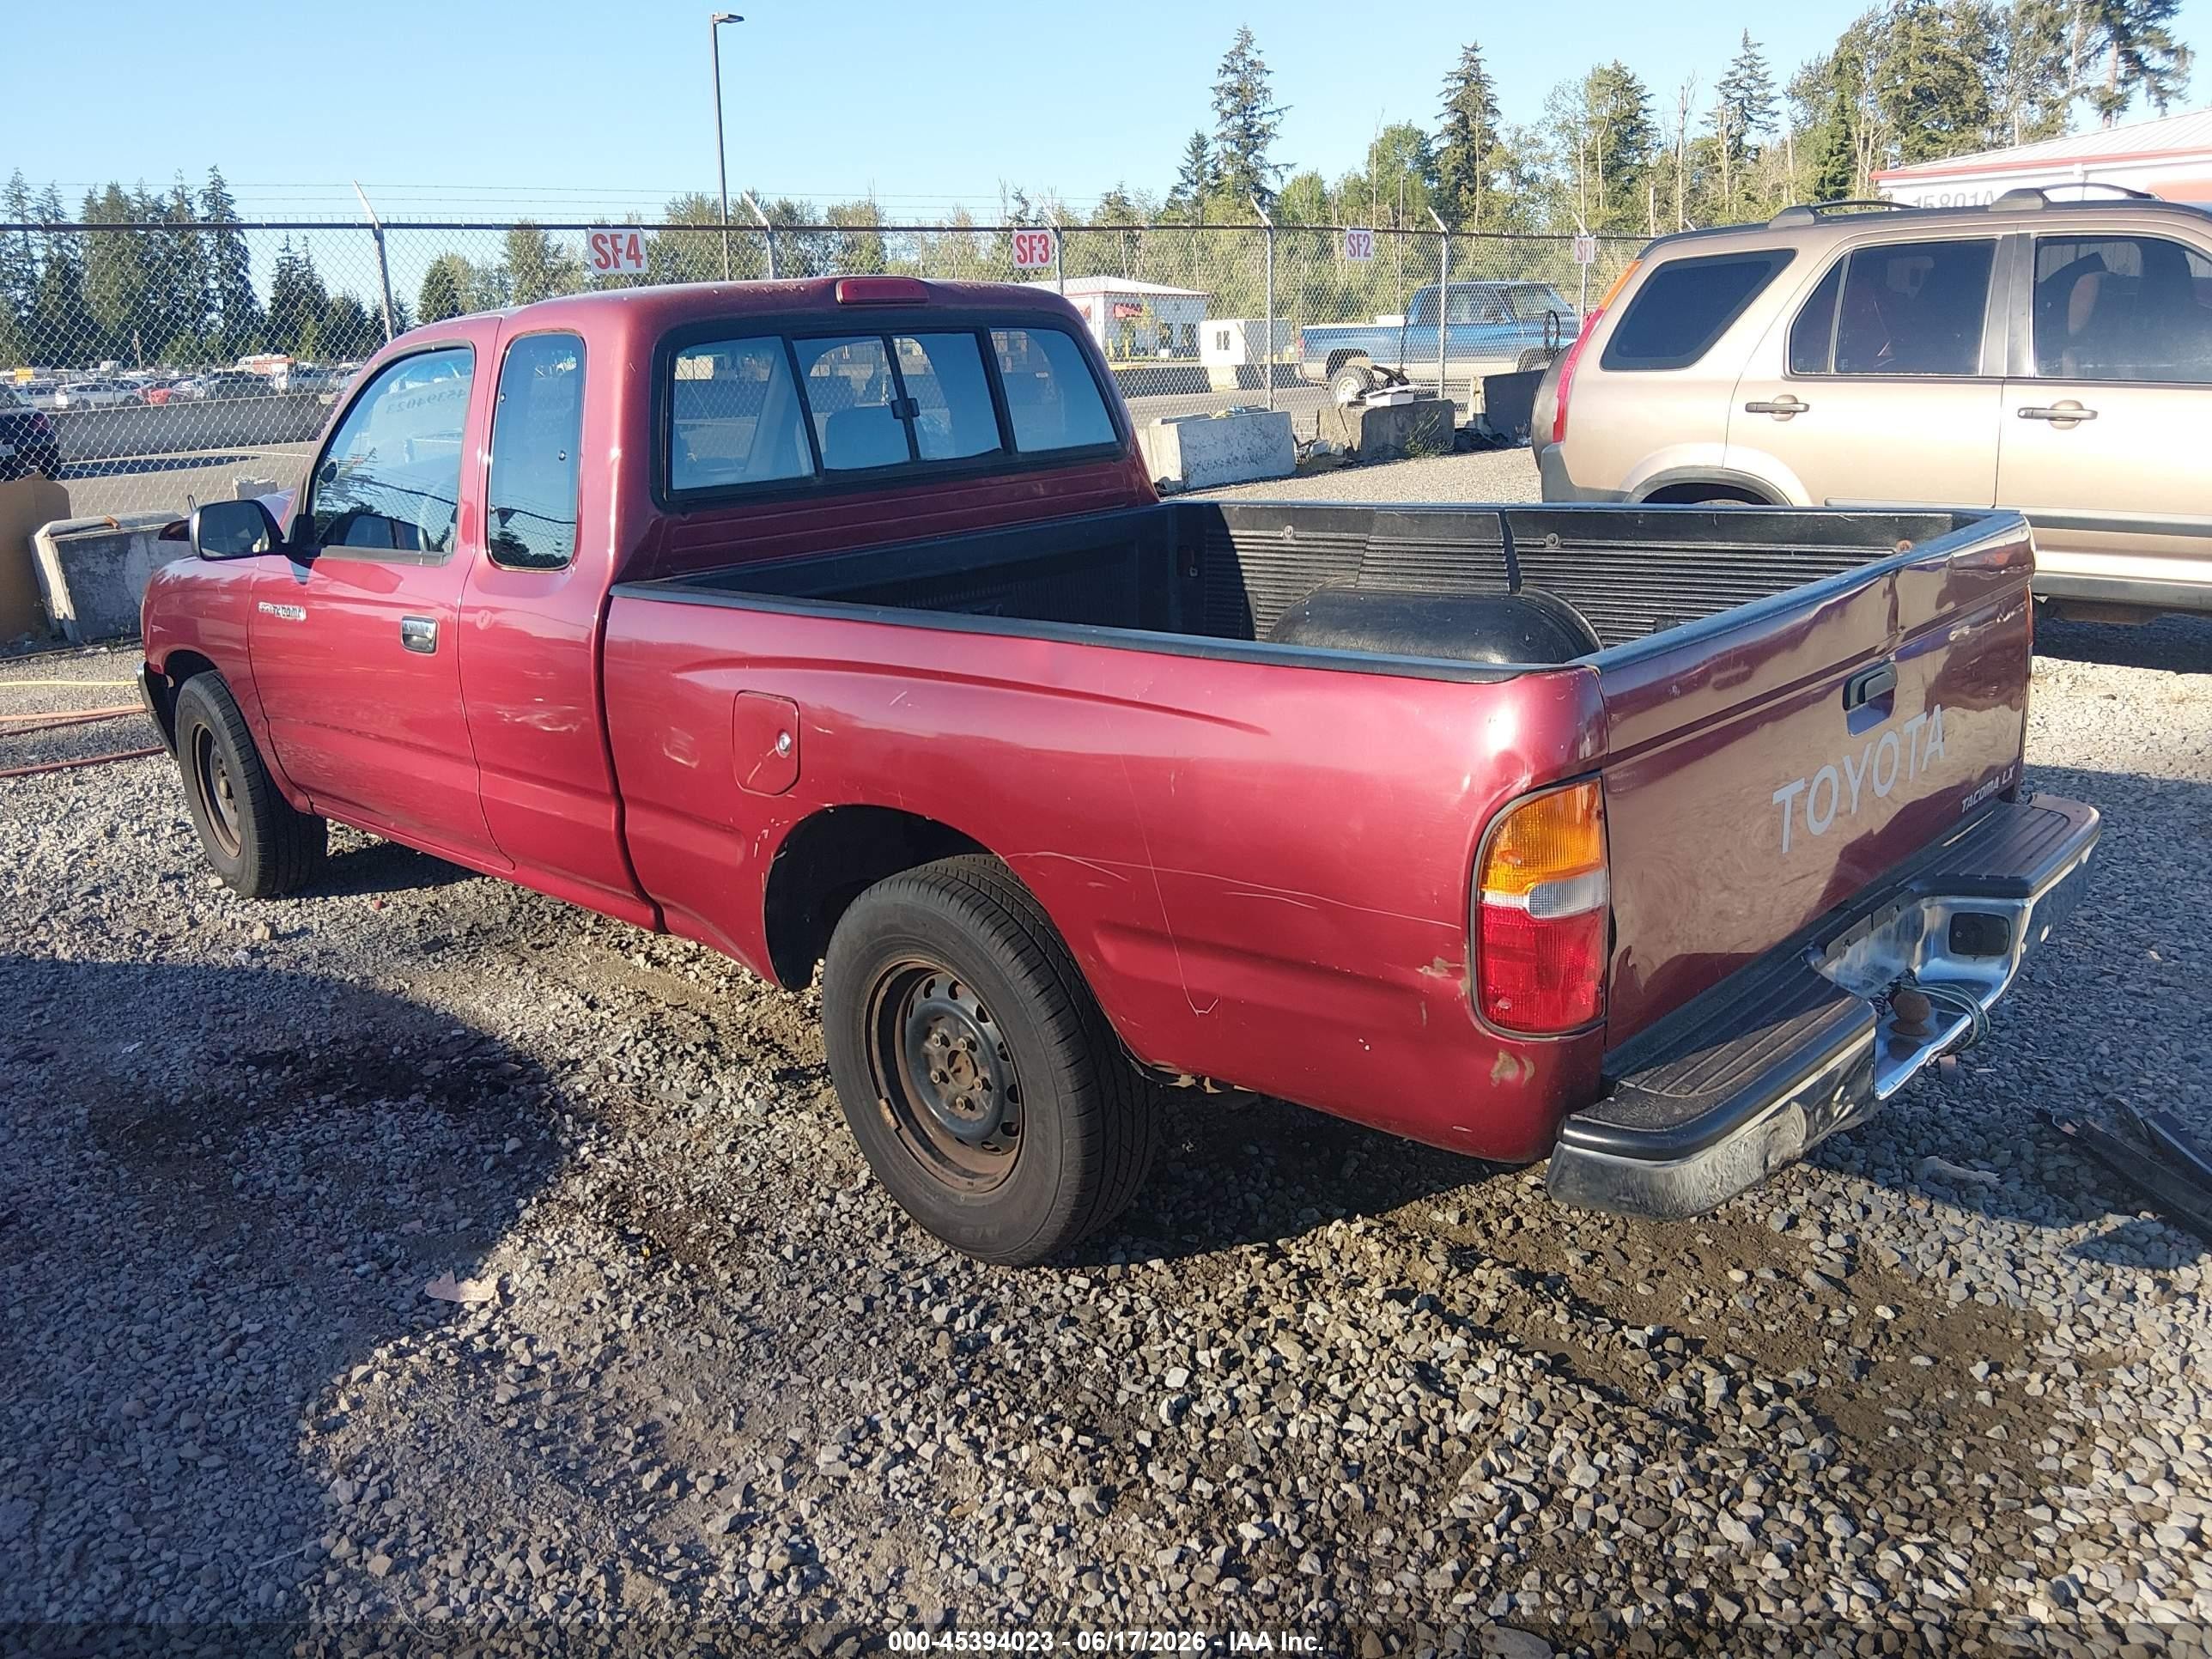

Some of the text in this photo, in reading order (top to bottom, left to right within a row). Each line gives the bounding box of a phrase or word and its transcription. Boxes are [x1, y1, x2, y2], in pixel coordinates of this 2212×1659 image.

[592, 234, 643, 269] SF4
[1016, 234, 1050, 265] SF3
[1347, 234, 1371, 258] SF2
[1577, 241, 1593, 262] SF1
[1772, 704, 1945, 854] TOYOTA
[1961, 765, 2015, 813] TACOMA LX
